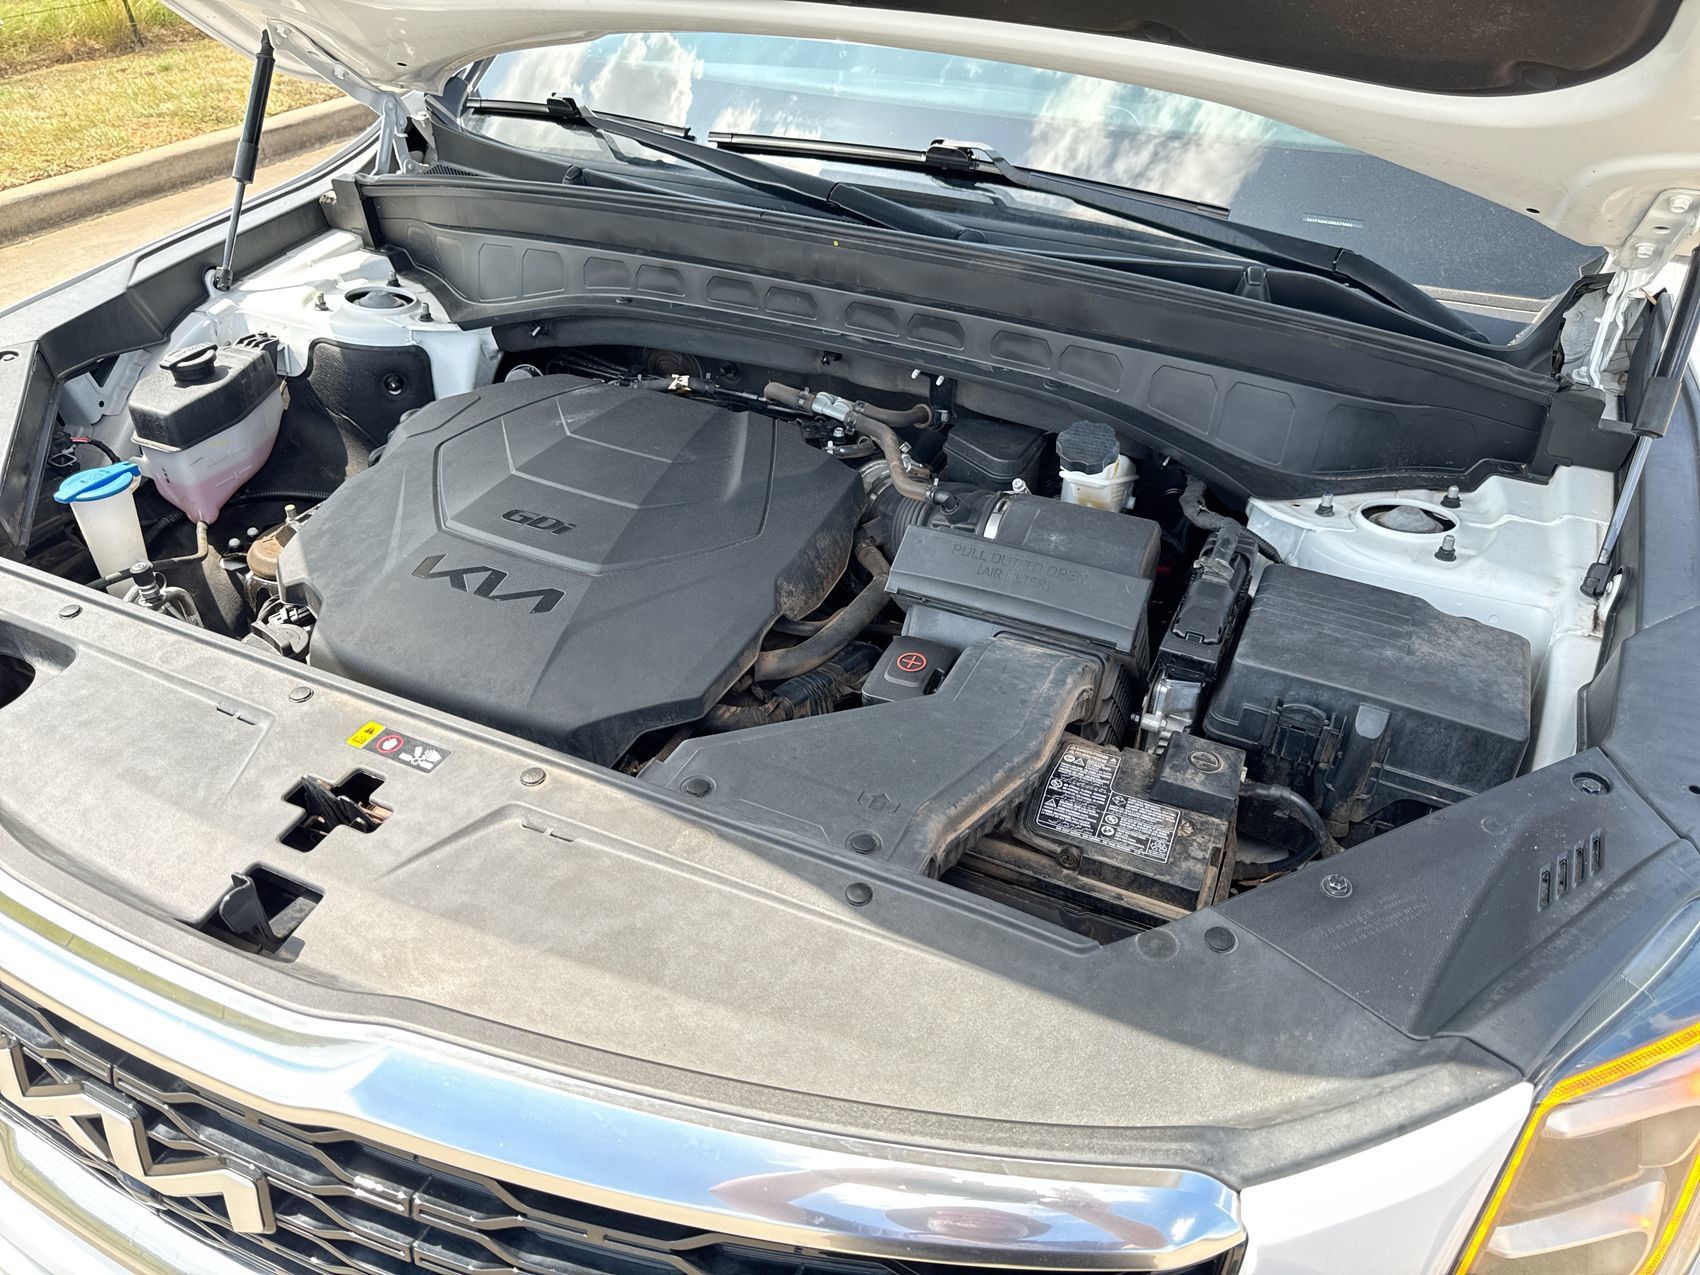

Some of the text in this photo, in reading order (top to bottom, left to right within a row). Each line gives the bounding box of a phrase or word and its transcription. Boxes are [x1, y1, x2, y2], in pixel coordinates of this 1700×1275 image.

[411, 553, 567, 615] KIA
[951, 543, 1089, 585] PULL OUT TO OPEN
